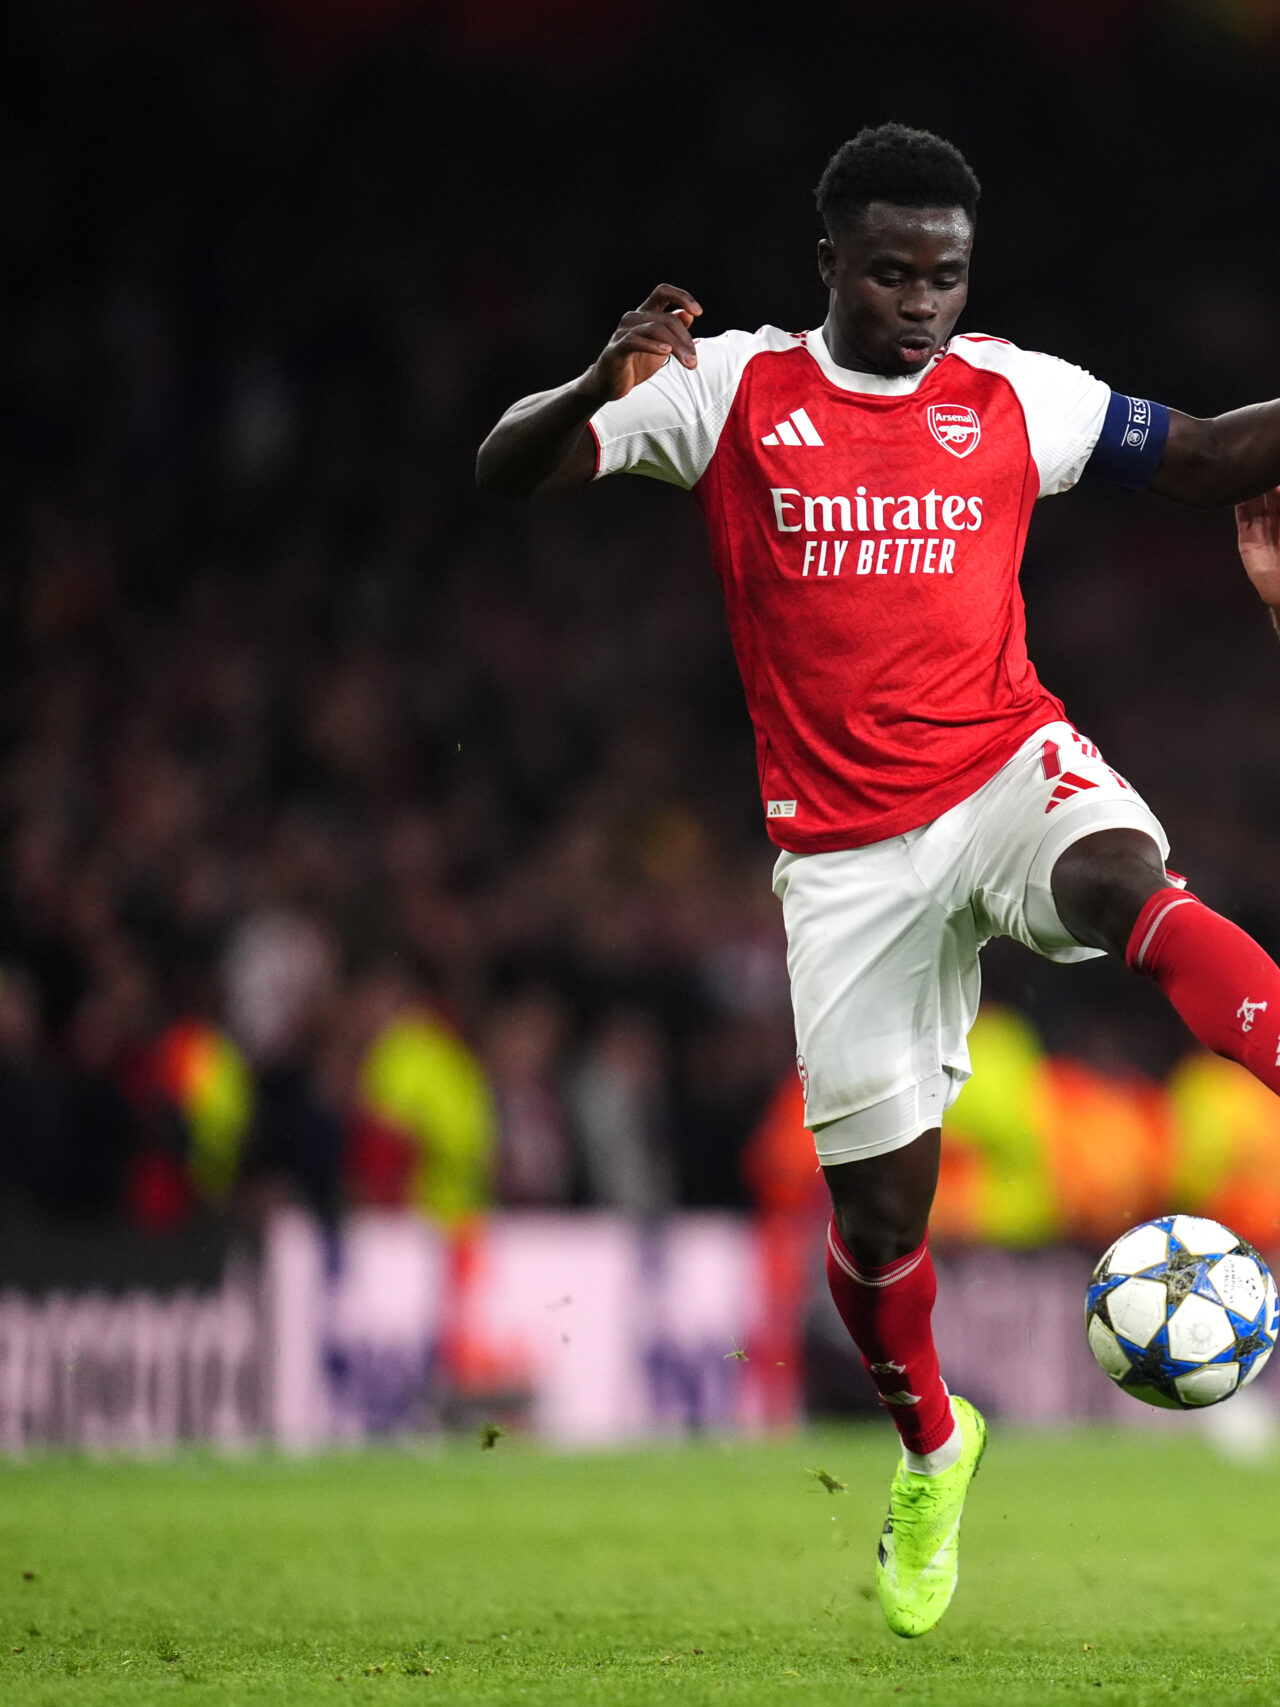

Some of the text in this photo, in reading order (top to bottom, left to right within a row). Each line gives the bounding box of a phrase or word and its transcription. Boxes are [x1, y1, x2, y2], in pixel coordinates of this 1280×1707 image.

[935, 412, 973, 424] Arsenal
[769, 486, 983, 532] Emirates
[802, 538, 956, 577] FLY BETTER
